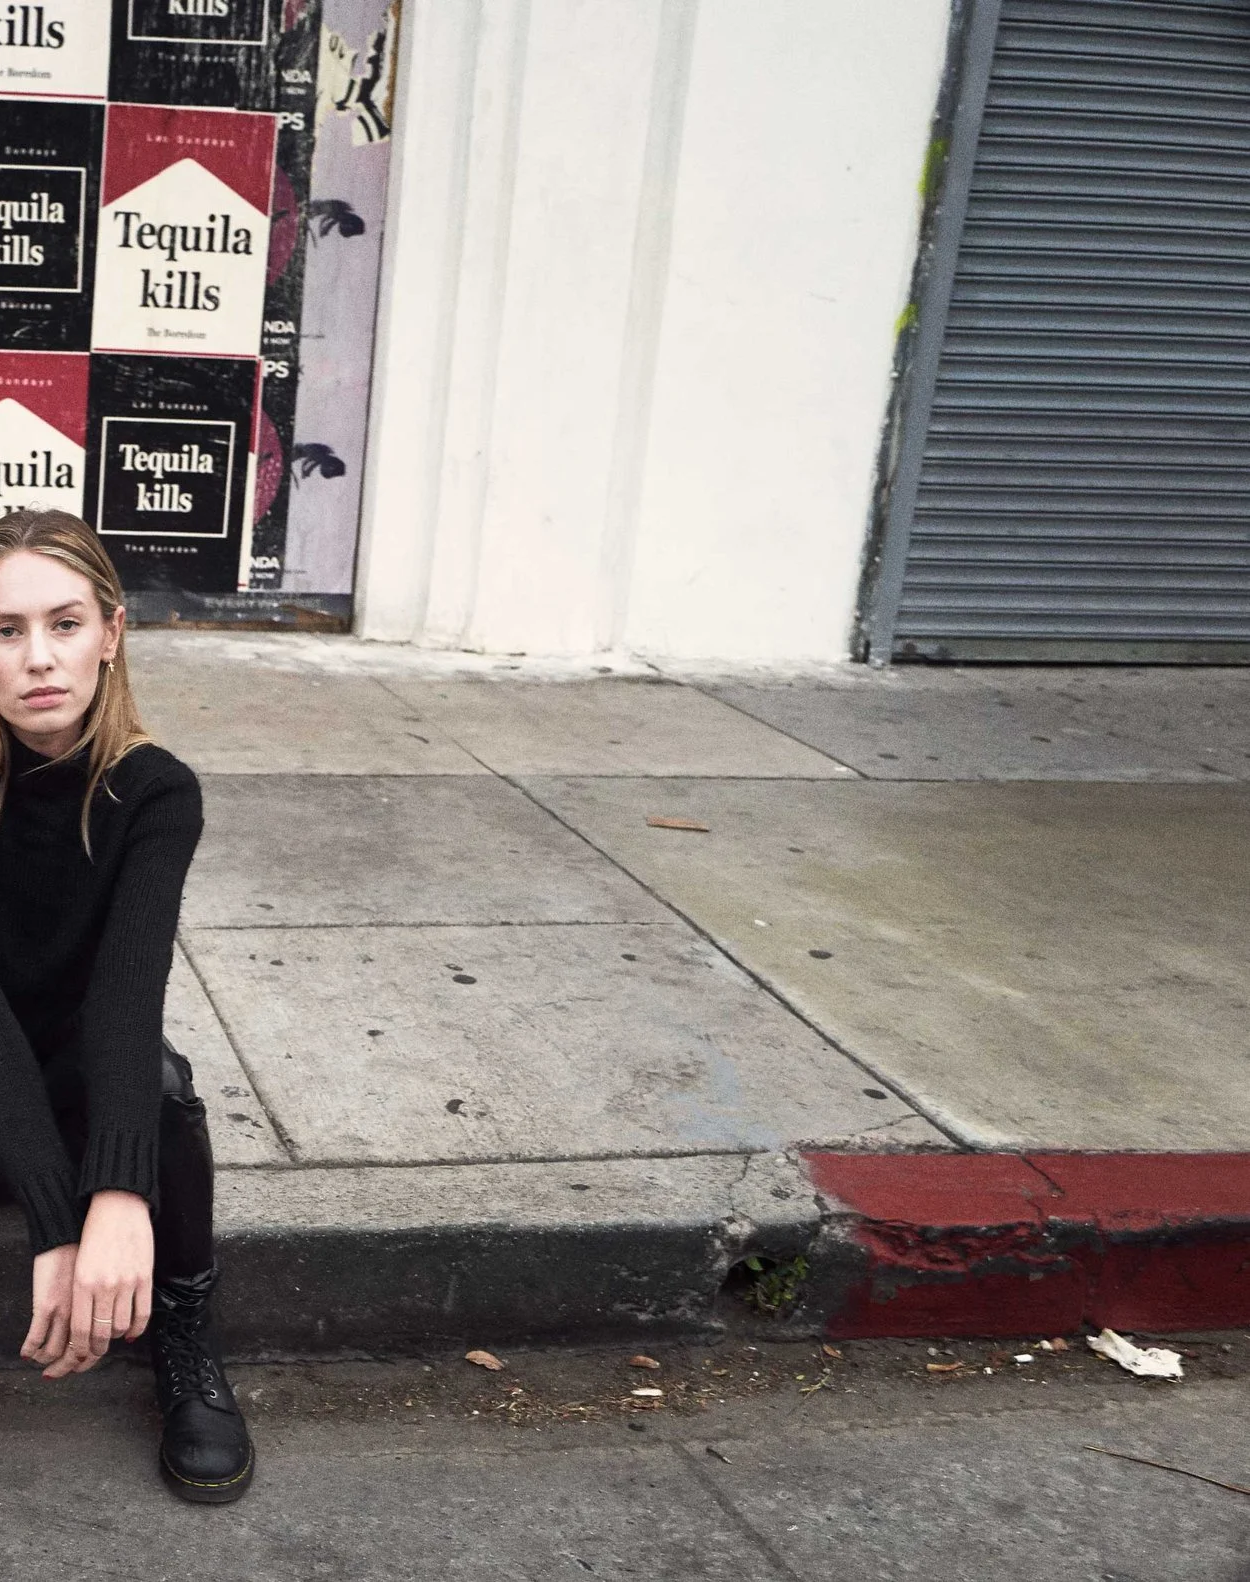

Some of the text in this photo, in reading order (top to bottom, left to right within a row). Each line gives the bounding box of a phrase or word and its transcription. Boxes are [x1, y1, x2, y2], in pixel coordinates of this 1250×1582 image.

[114, 211, 254, 261] Tequila
[139, 269, 220, 312] kills
[263, 320, 297, 334] NDA
[119, 444, 215, 478] Tequila
[136, 482, 193, 513] kills
[123, 542, 146, 553] The
